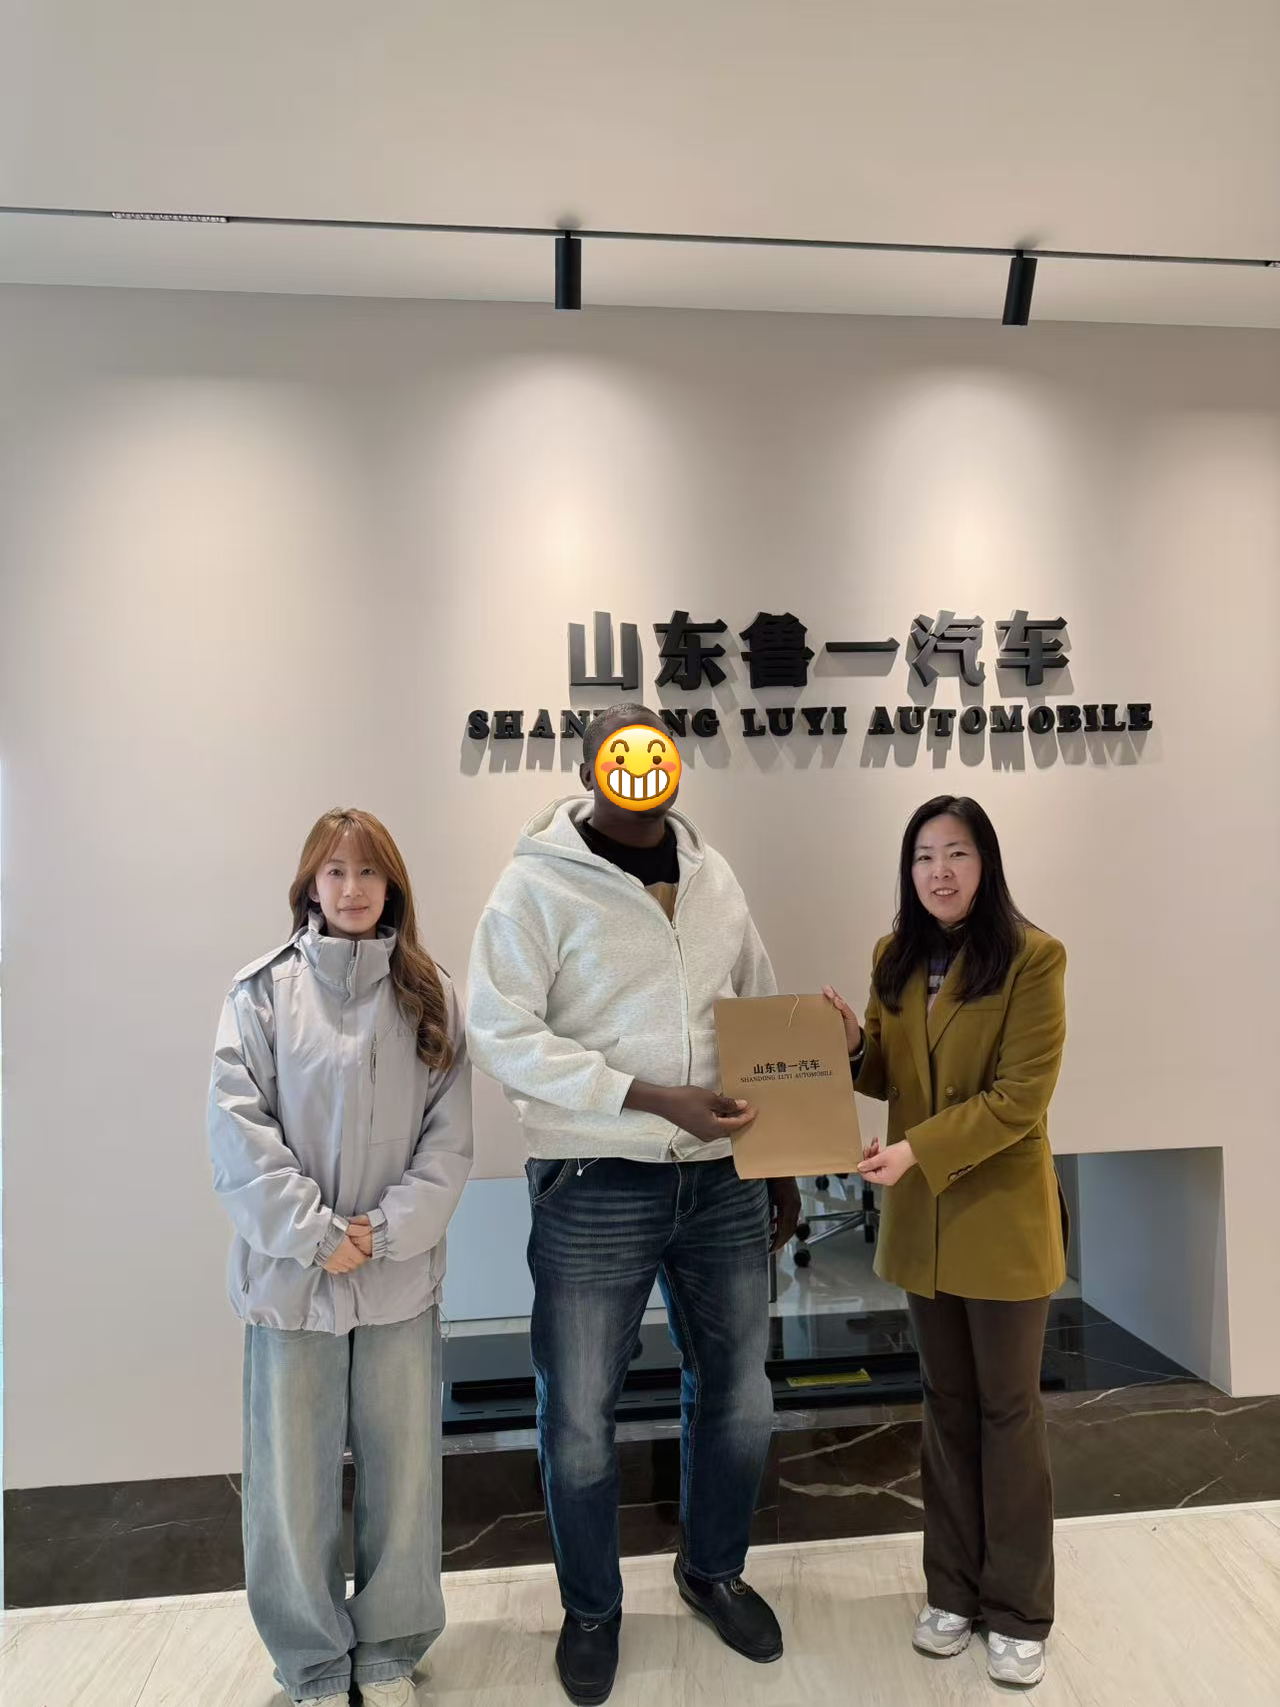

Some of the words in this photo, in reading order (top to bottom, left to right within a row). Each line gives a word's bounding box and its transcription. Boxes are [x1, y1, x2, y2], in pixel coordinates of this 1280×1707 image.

[568, 610, 1069, 690] 山东鲁一汽车
[468, 708, 720, 739] SHANNG
[740, 706, 847, 737] LUYI
[868, 703, 1152, 736] AUTOMOBILE
[753, 1059, 820, 1075] 山东鲁一汽车
